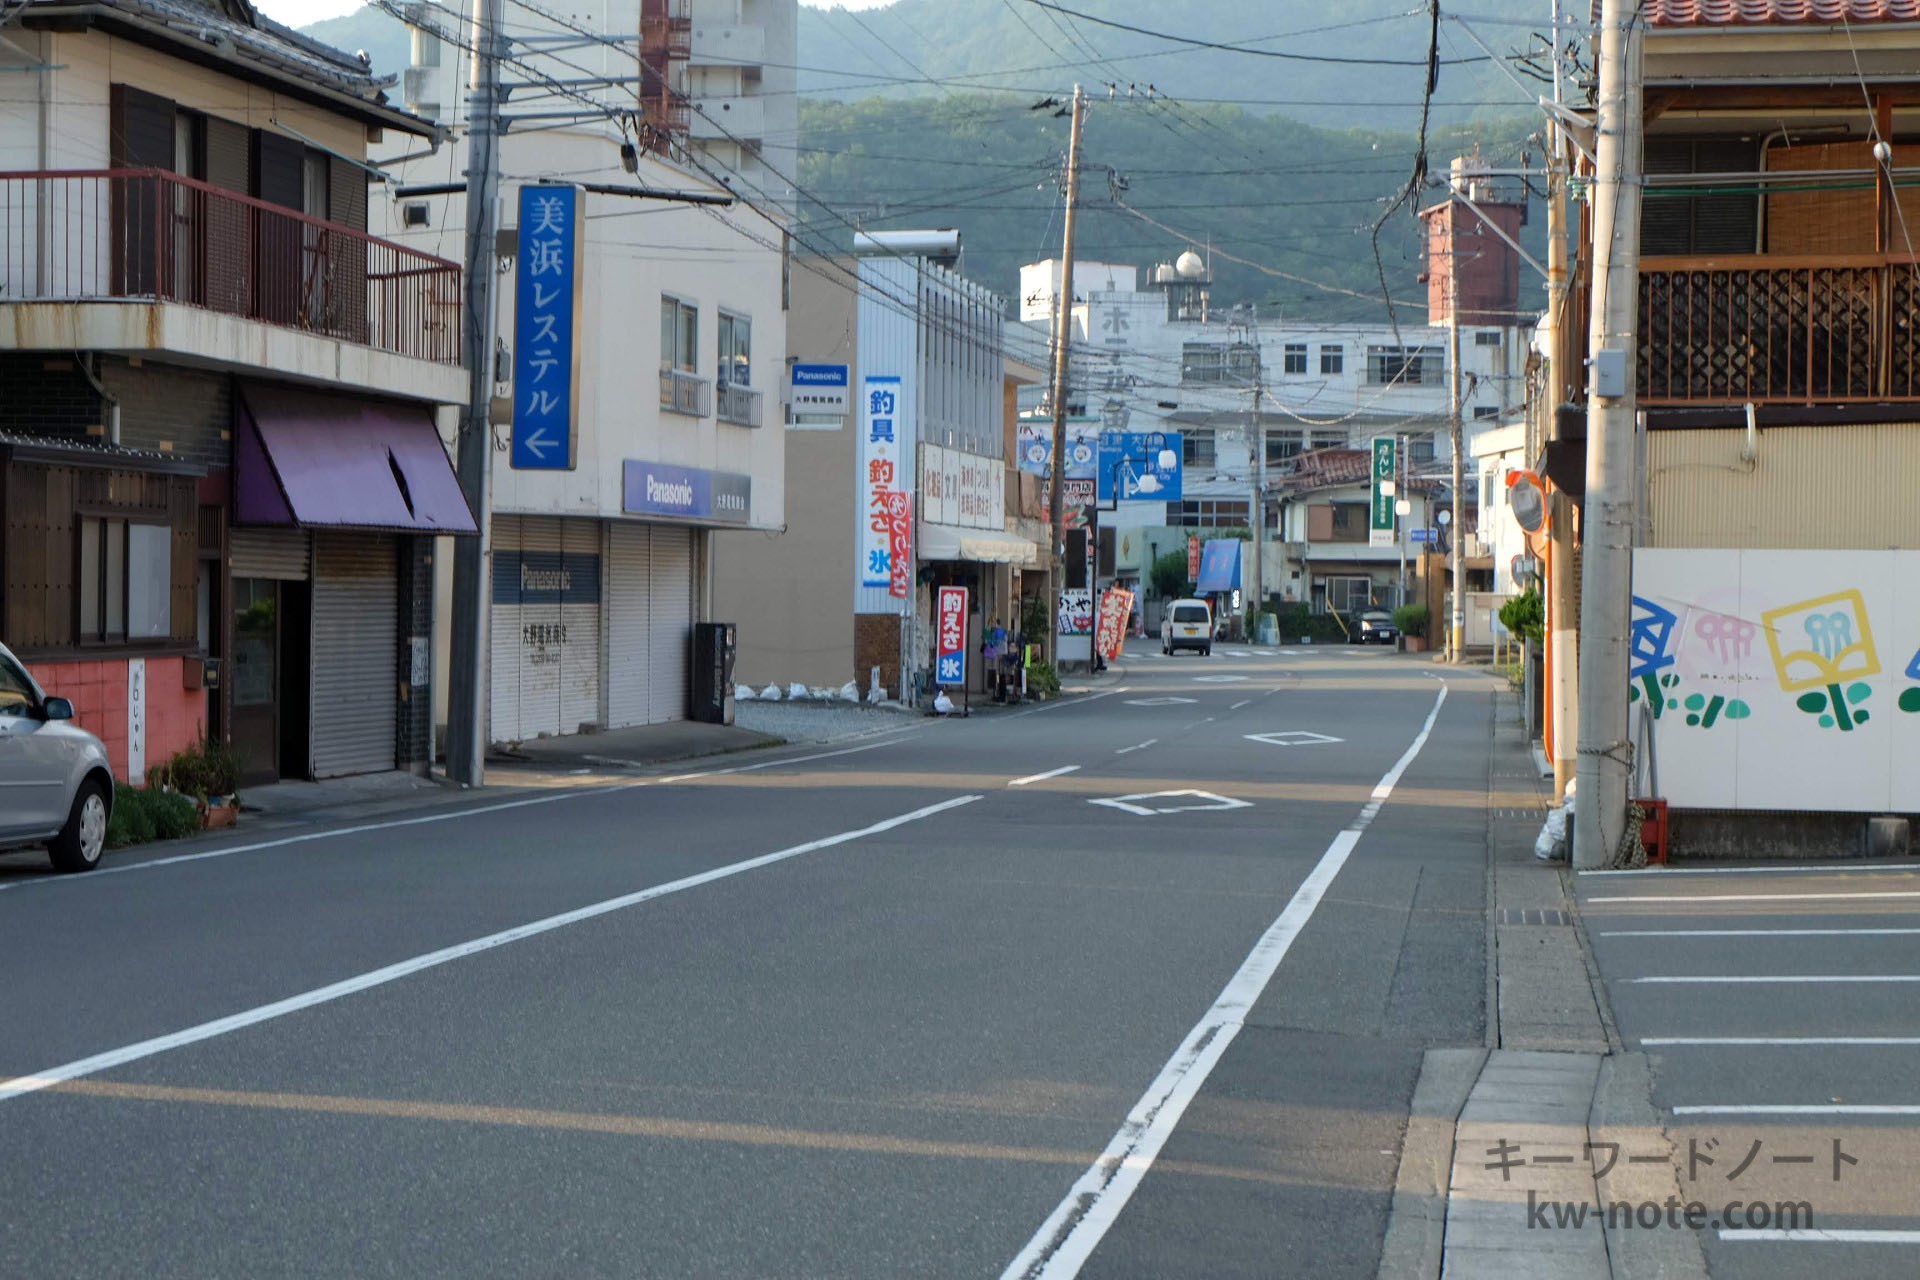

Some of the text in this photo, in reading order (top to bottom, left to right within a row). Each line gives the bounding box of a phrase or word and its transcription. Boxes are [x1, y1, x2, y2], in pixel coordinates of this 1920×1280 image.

[525, 197, 565, 417] 美浜レステル
[797, 371, 841, 381] Panasonic
[647, 474, 692, 506] Panasonic
[521, 564, 570, 591] Panasonic
[943, 592, 962, 649] 釣えさ
[942, 659, 960, 678] 氷
